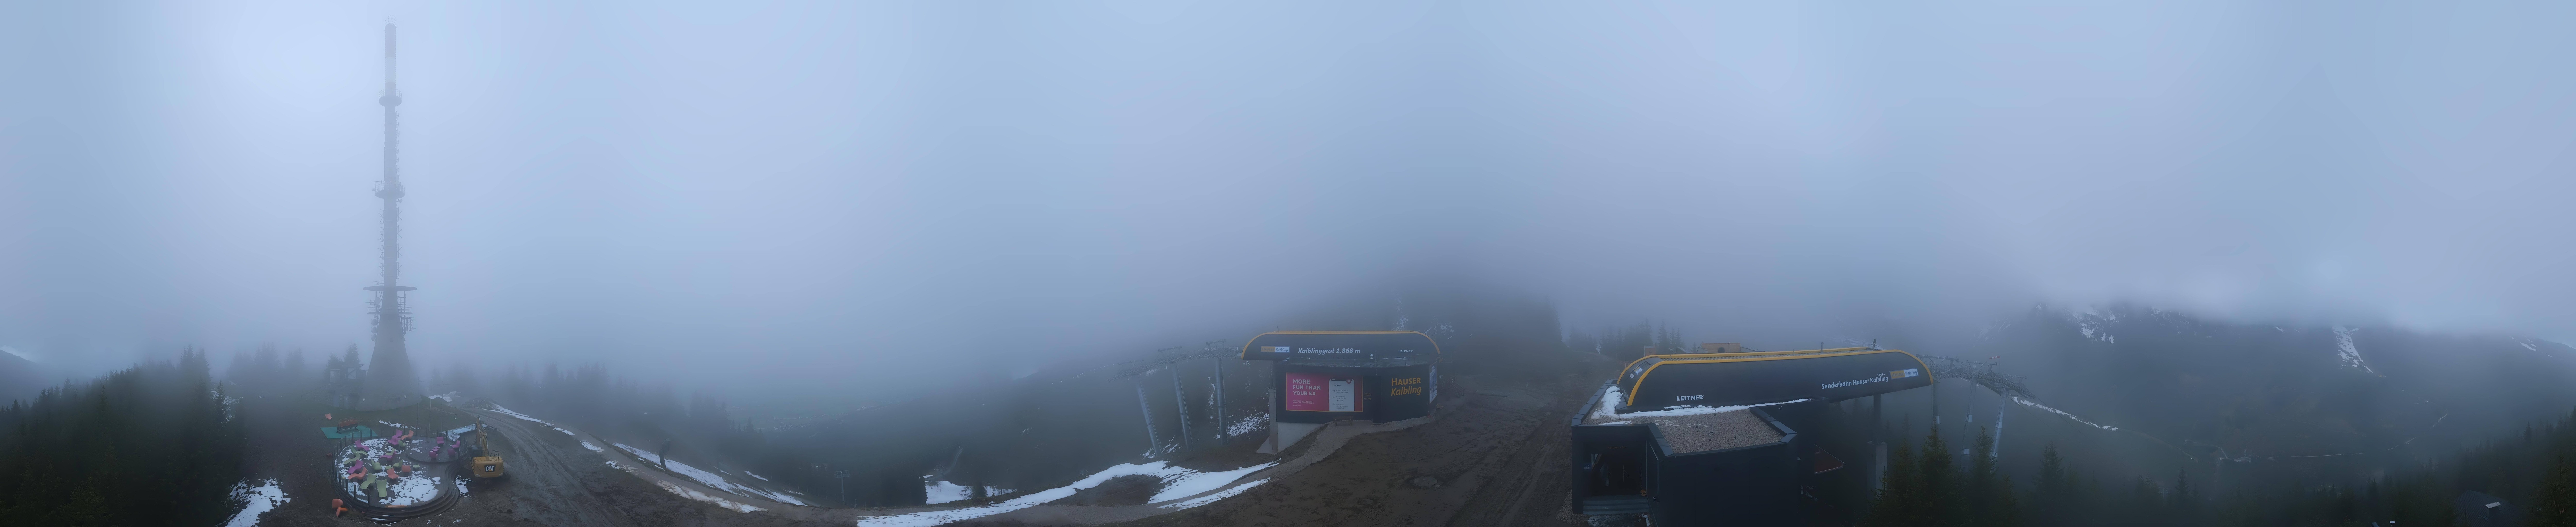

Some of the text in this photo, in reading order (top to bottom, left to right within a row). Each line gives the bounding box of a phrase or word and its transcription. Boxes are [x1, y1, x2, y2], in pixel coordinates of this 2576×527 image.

[1392, 377, 1421, 386] HAUSER
[1822, 381, 1852, 389] Senderbahn
[1391, 386, 1421, 396] Kaibling
